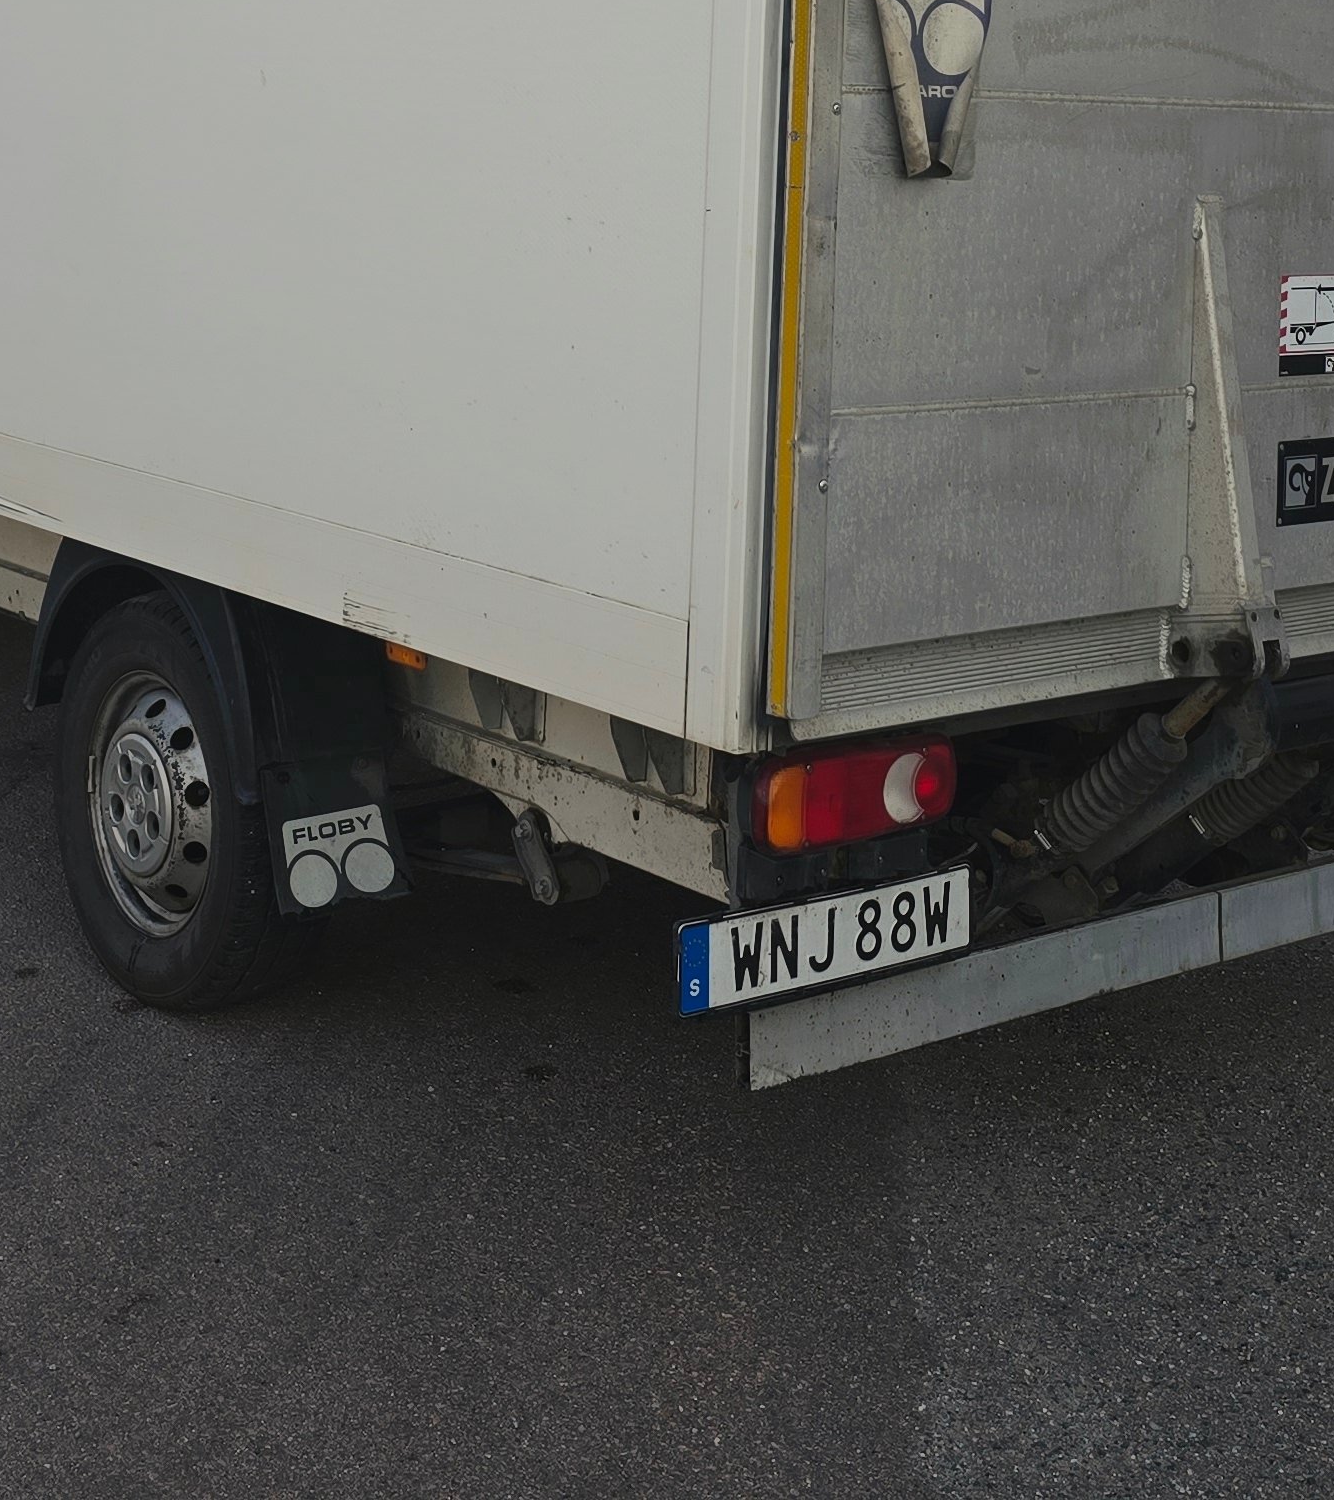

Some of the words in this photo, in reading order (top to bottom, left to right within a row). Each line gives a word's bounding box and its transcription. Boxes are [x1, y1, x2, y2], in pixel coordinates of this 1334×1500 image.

[292, 813, 372, 844] FLOBY
[730, 906, 835, 992] WNJ
[855, 880, 951, 961] 88W
[689, 978, 700, 997] S
